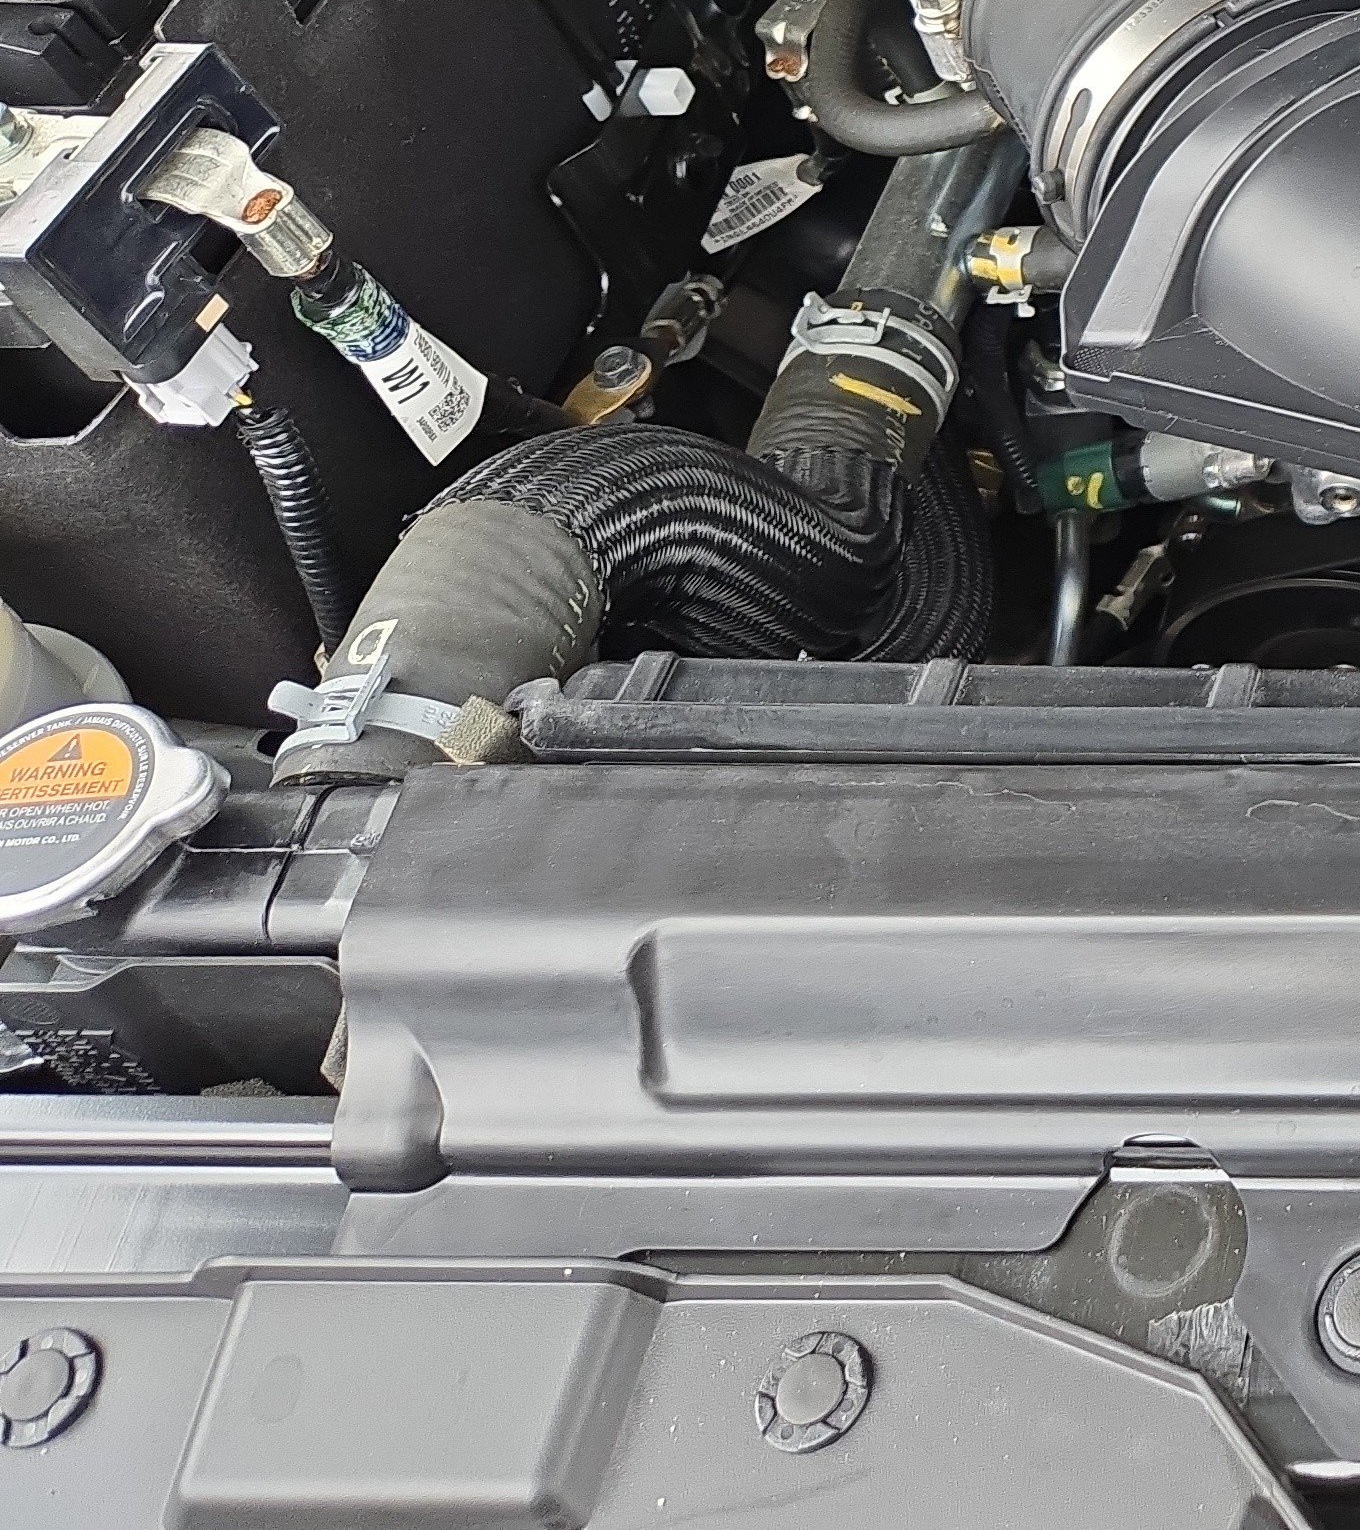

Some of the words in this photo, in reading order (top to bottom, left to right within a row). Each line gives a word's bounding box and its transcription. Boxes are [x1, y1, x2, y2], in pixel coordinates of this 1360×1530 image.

[10, 762, 107, 783] WARNING
[9, 806, 45, 817] OPEN
[46, 802, 80, 815] WHEN
[5, 837, 40, 847] MOTOR
